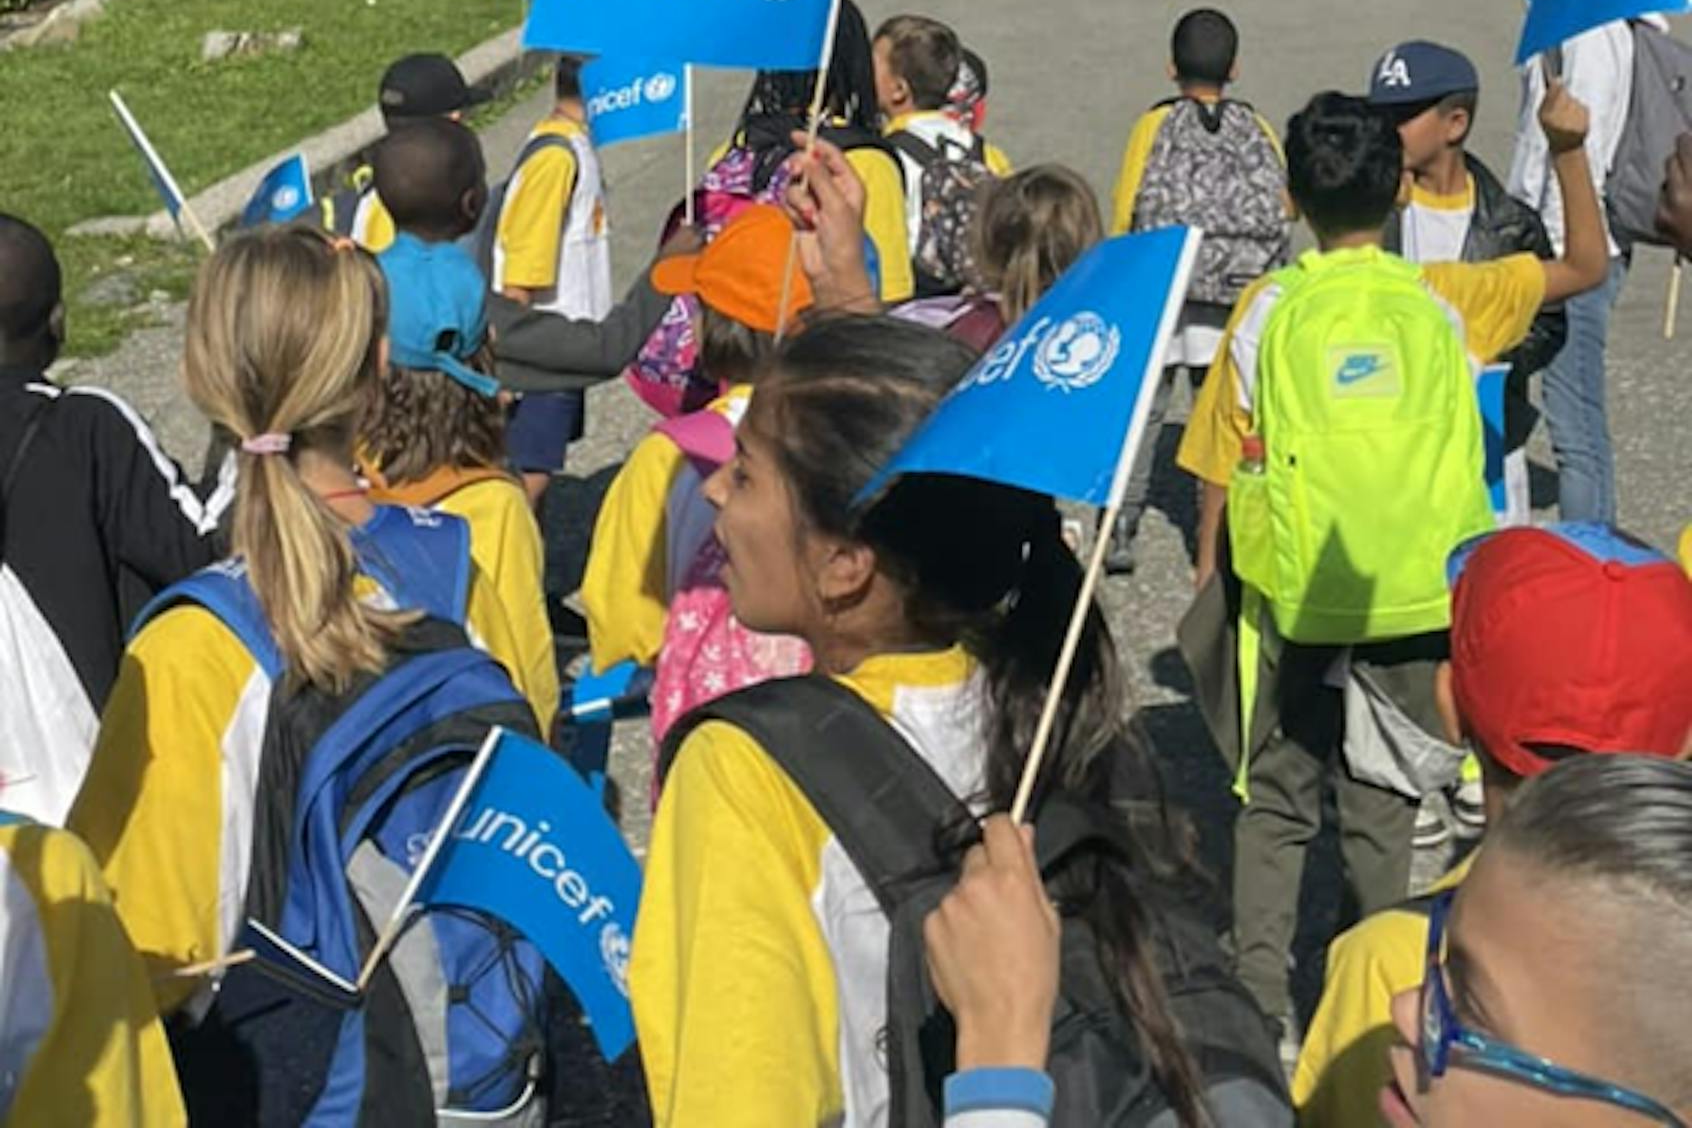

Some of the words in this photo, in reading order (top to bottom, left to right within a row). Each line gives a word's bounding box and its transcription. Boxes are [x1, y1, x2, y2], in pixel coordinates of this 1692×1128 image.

[1379, 51, 1411, 86] LA
[587, 77, 644, 121] nicef
[453, 807, 614, 924] unicef
